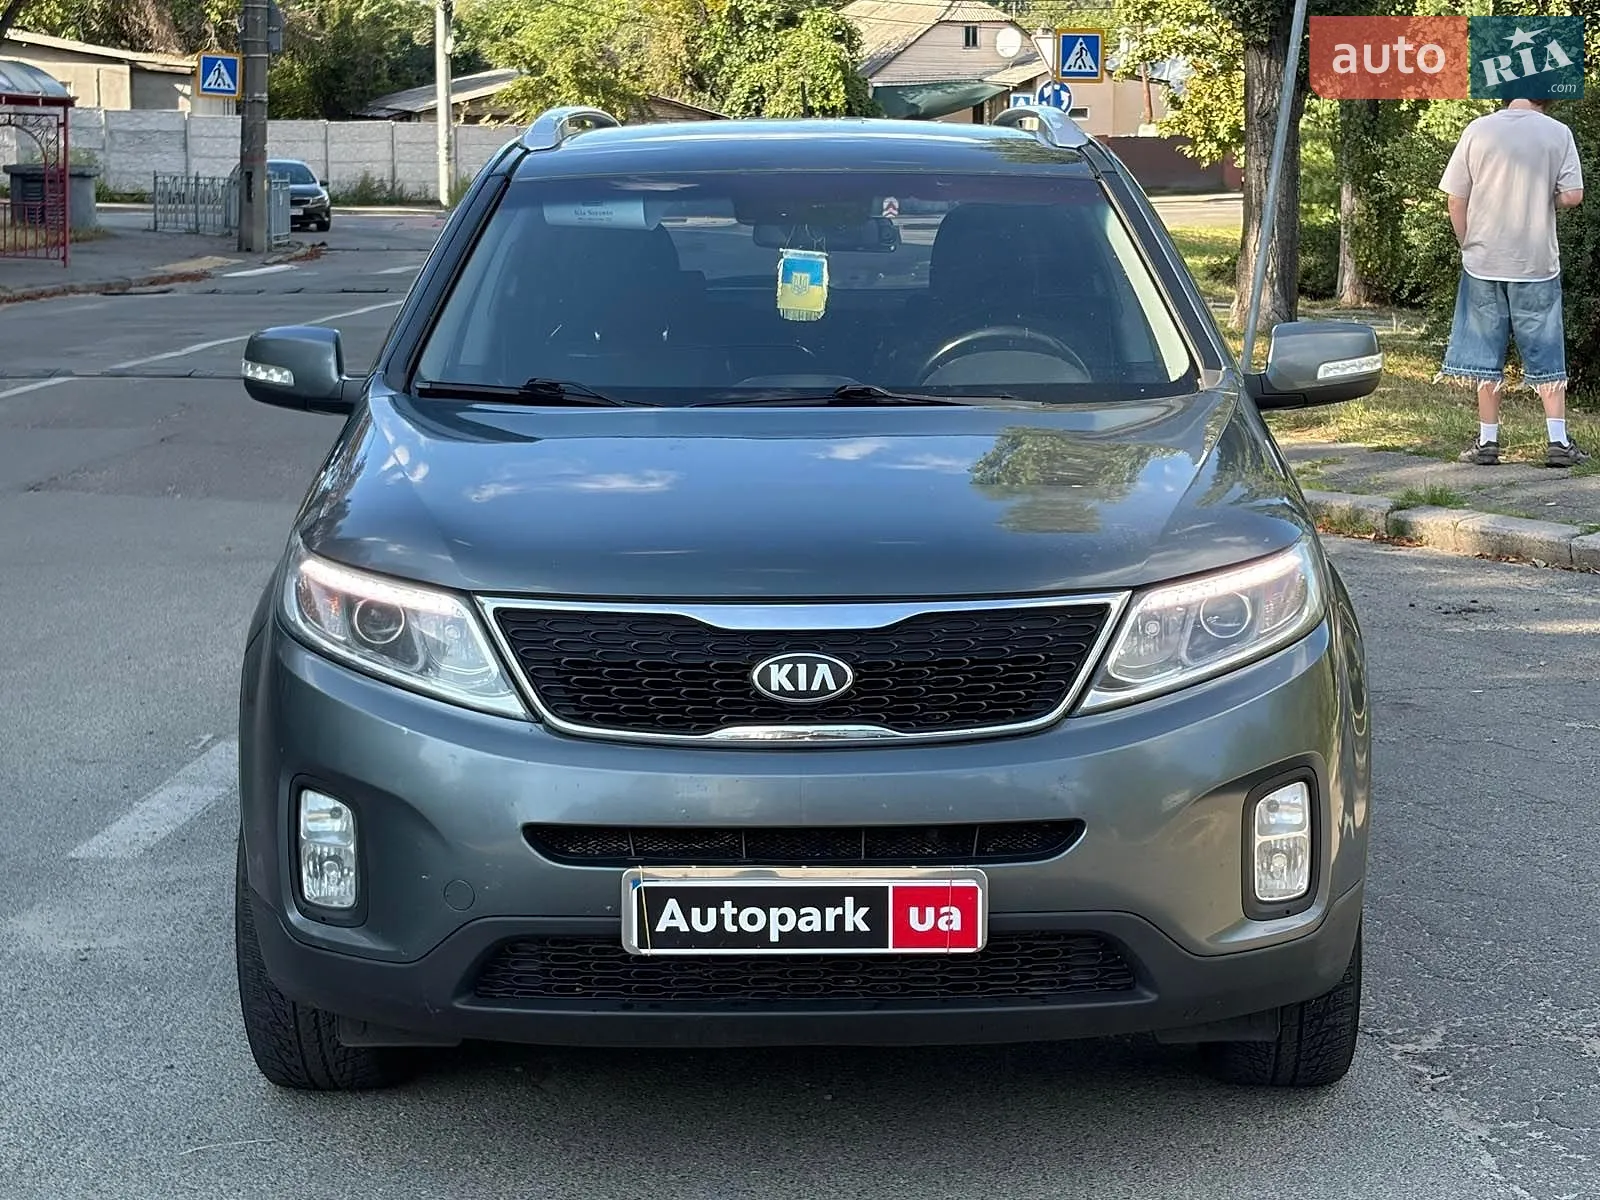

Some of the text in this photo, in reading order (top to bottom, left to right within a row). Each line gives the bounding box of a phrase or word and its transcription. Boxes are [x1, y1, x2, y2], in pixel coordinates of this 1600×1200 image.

[769, 663, 837, 691] KIA
[655, 896, 962, 942] Autopark ua
